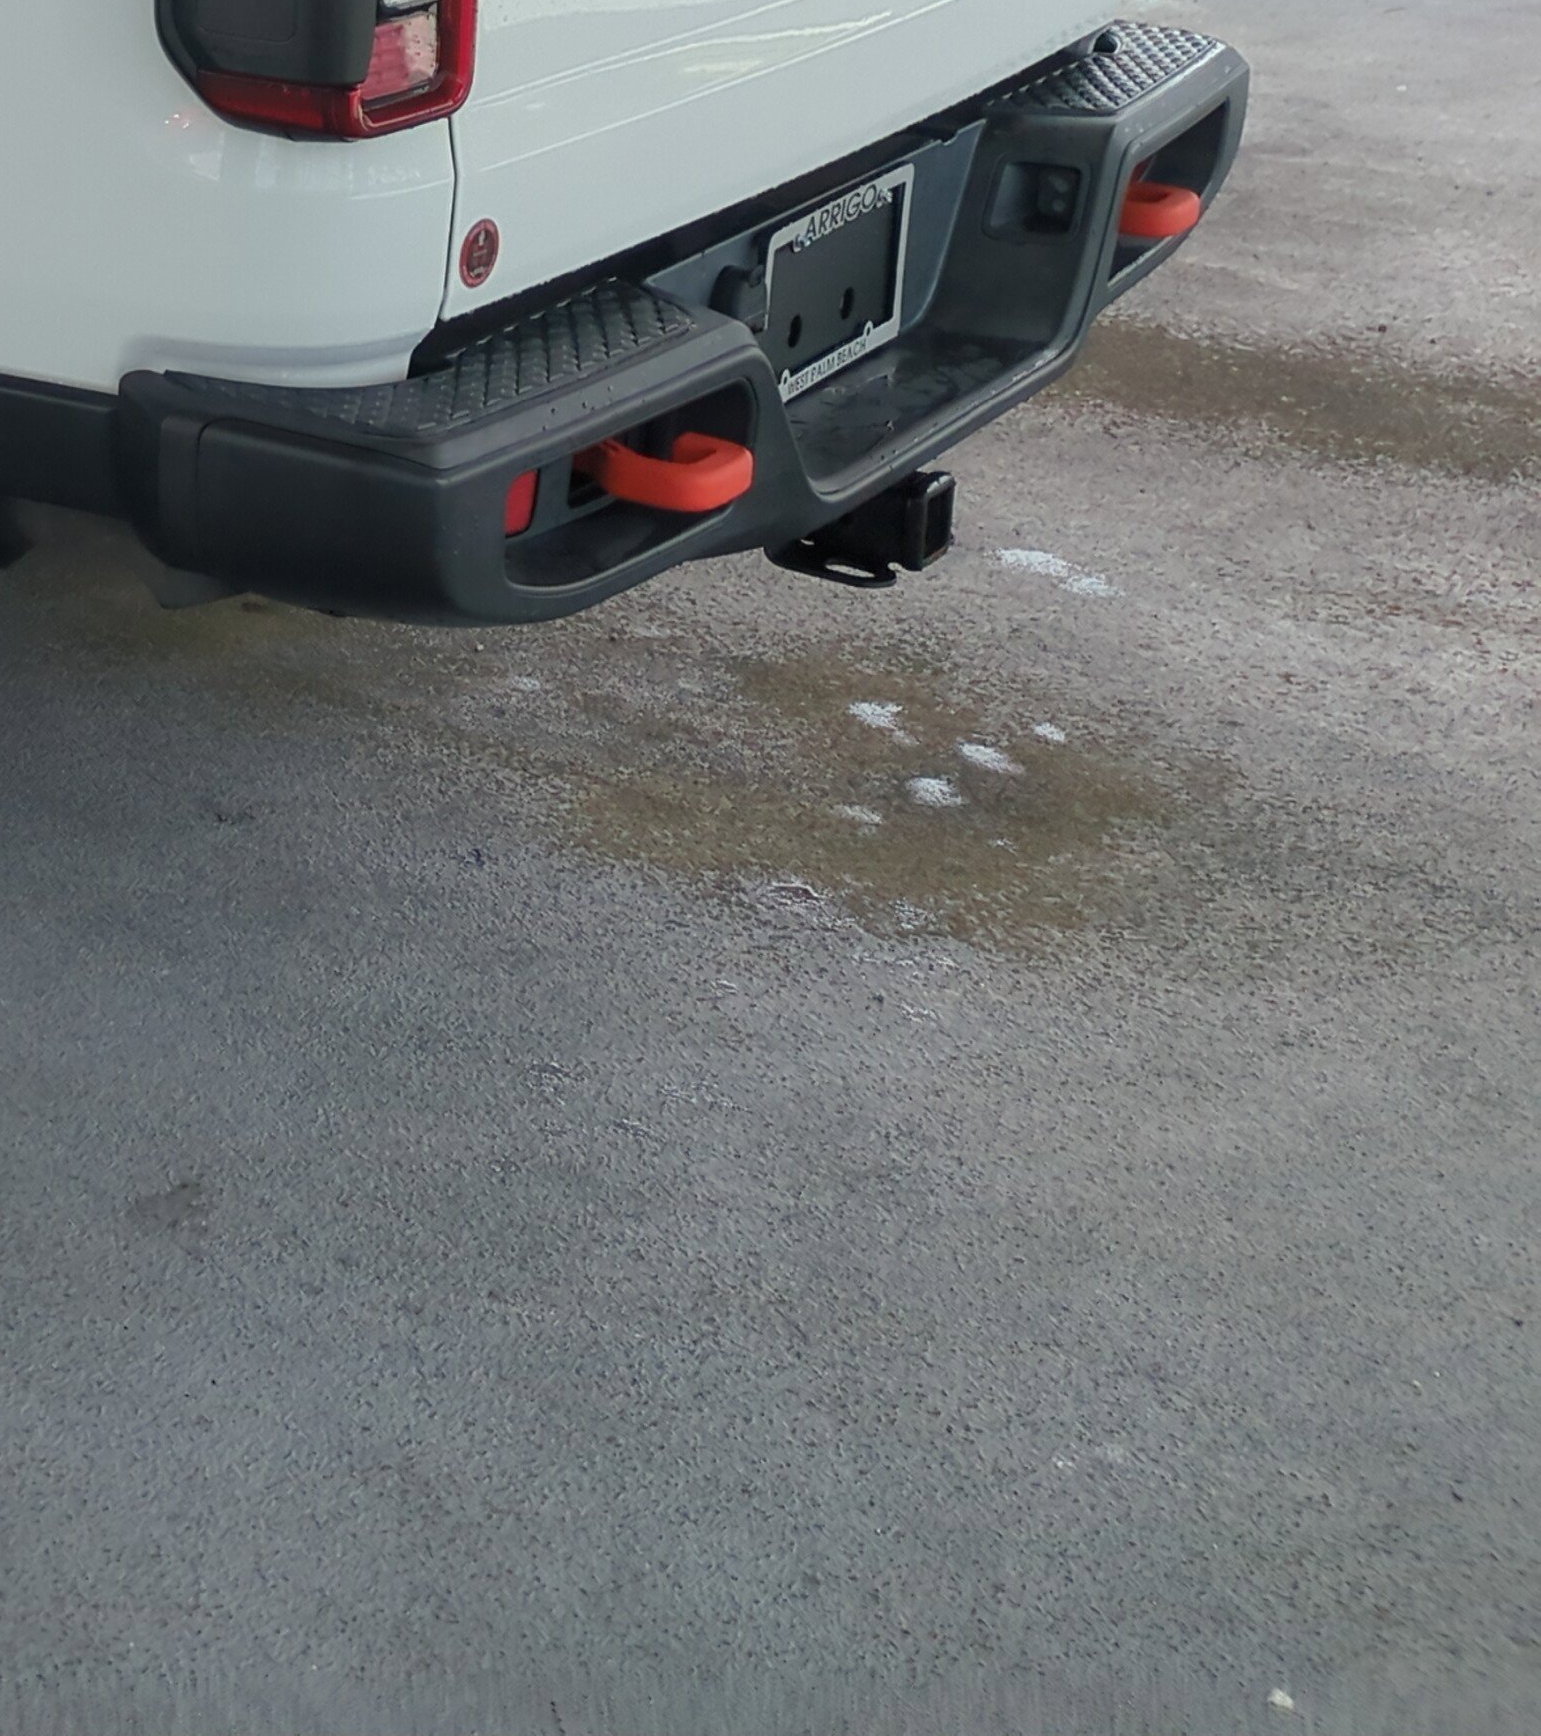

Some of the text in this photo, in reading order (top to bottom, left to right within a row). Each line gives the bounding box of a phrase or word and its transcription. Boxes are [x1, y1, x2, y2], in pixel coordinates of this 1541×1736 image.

[805, 184, 878, 242] ARRIGO
[787, 337, 867, 396] WEST PALM BEACH
